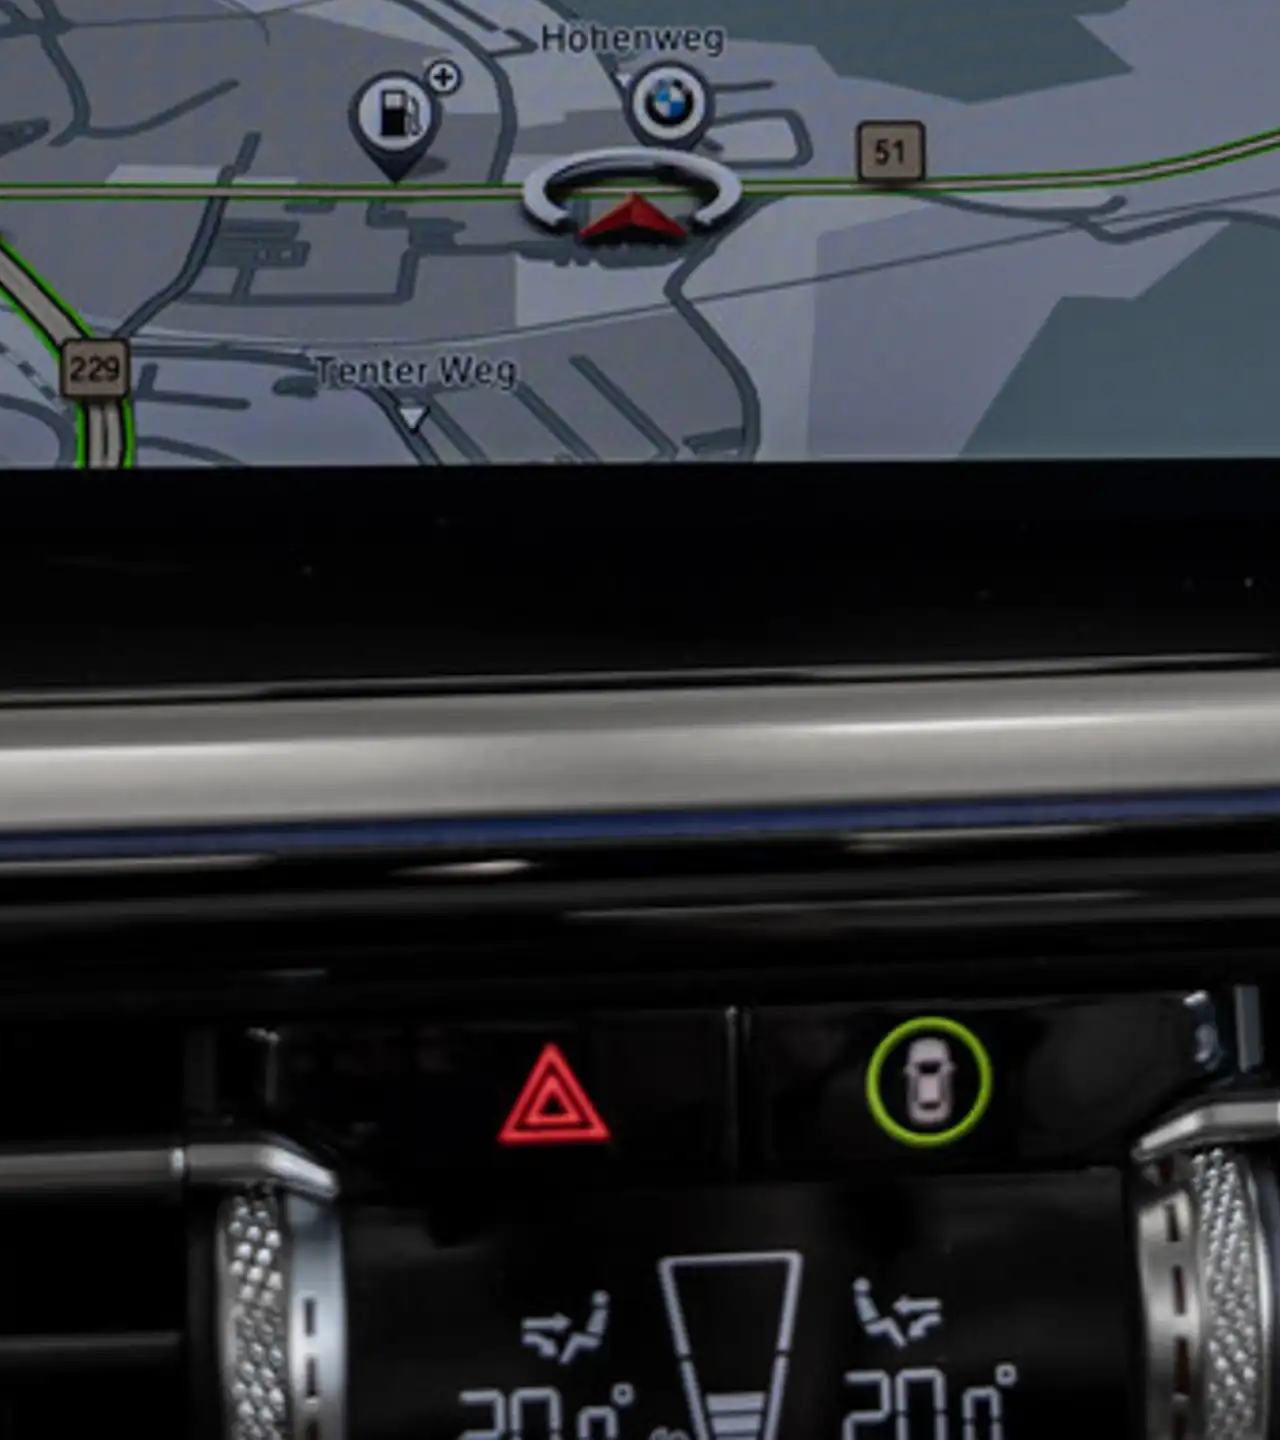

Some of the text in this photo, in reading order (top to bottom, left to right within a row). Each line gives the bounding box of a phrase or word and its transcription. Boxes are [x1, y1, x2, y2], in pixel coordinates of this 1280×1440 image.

[875, 138, 905, 166] 51
[69, 355, 121, 383] 229
[316, 356, 516, 390] Tenter Weg
